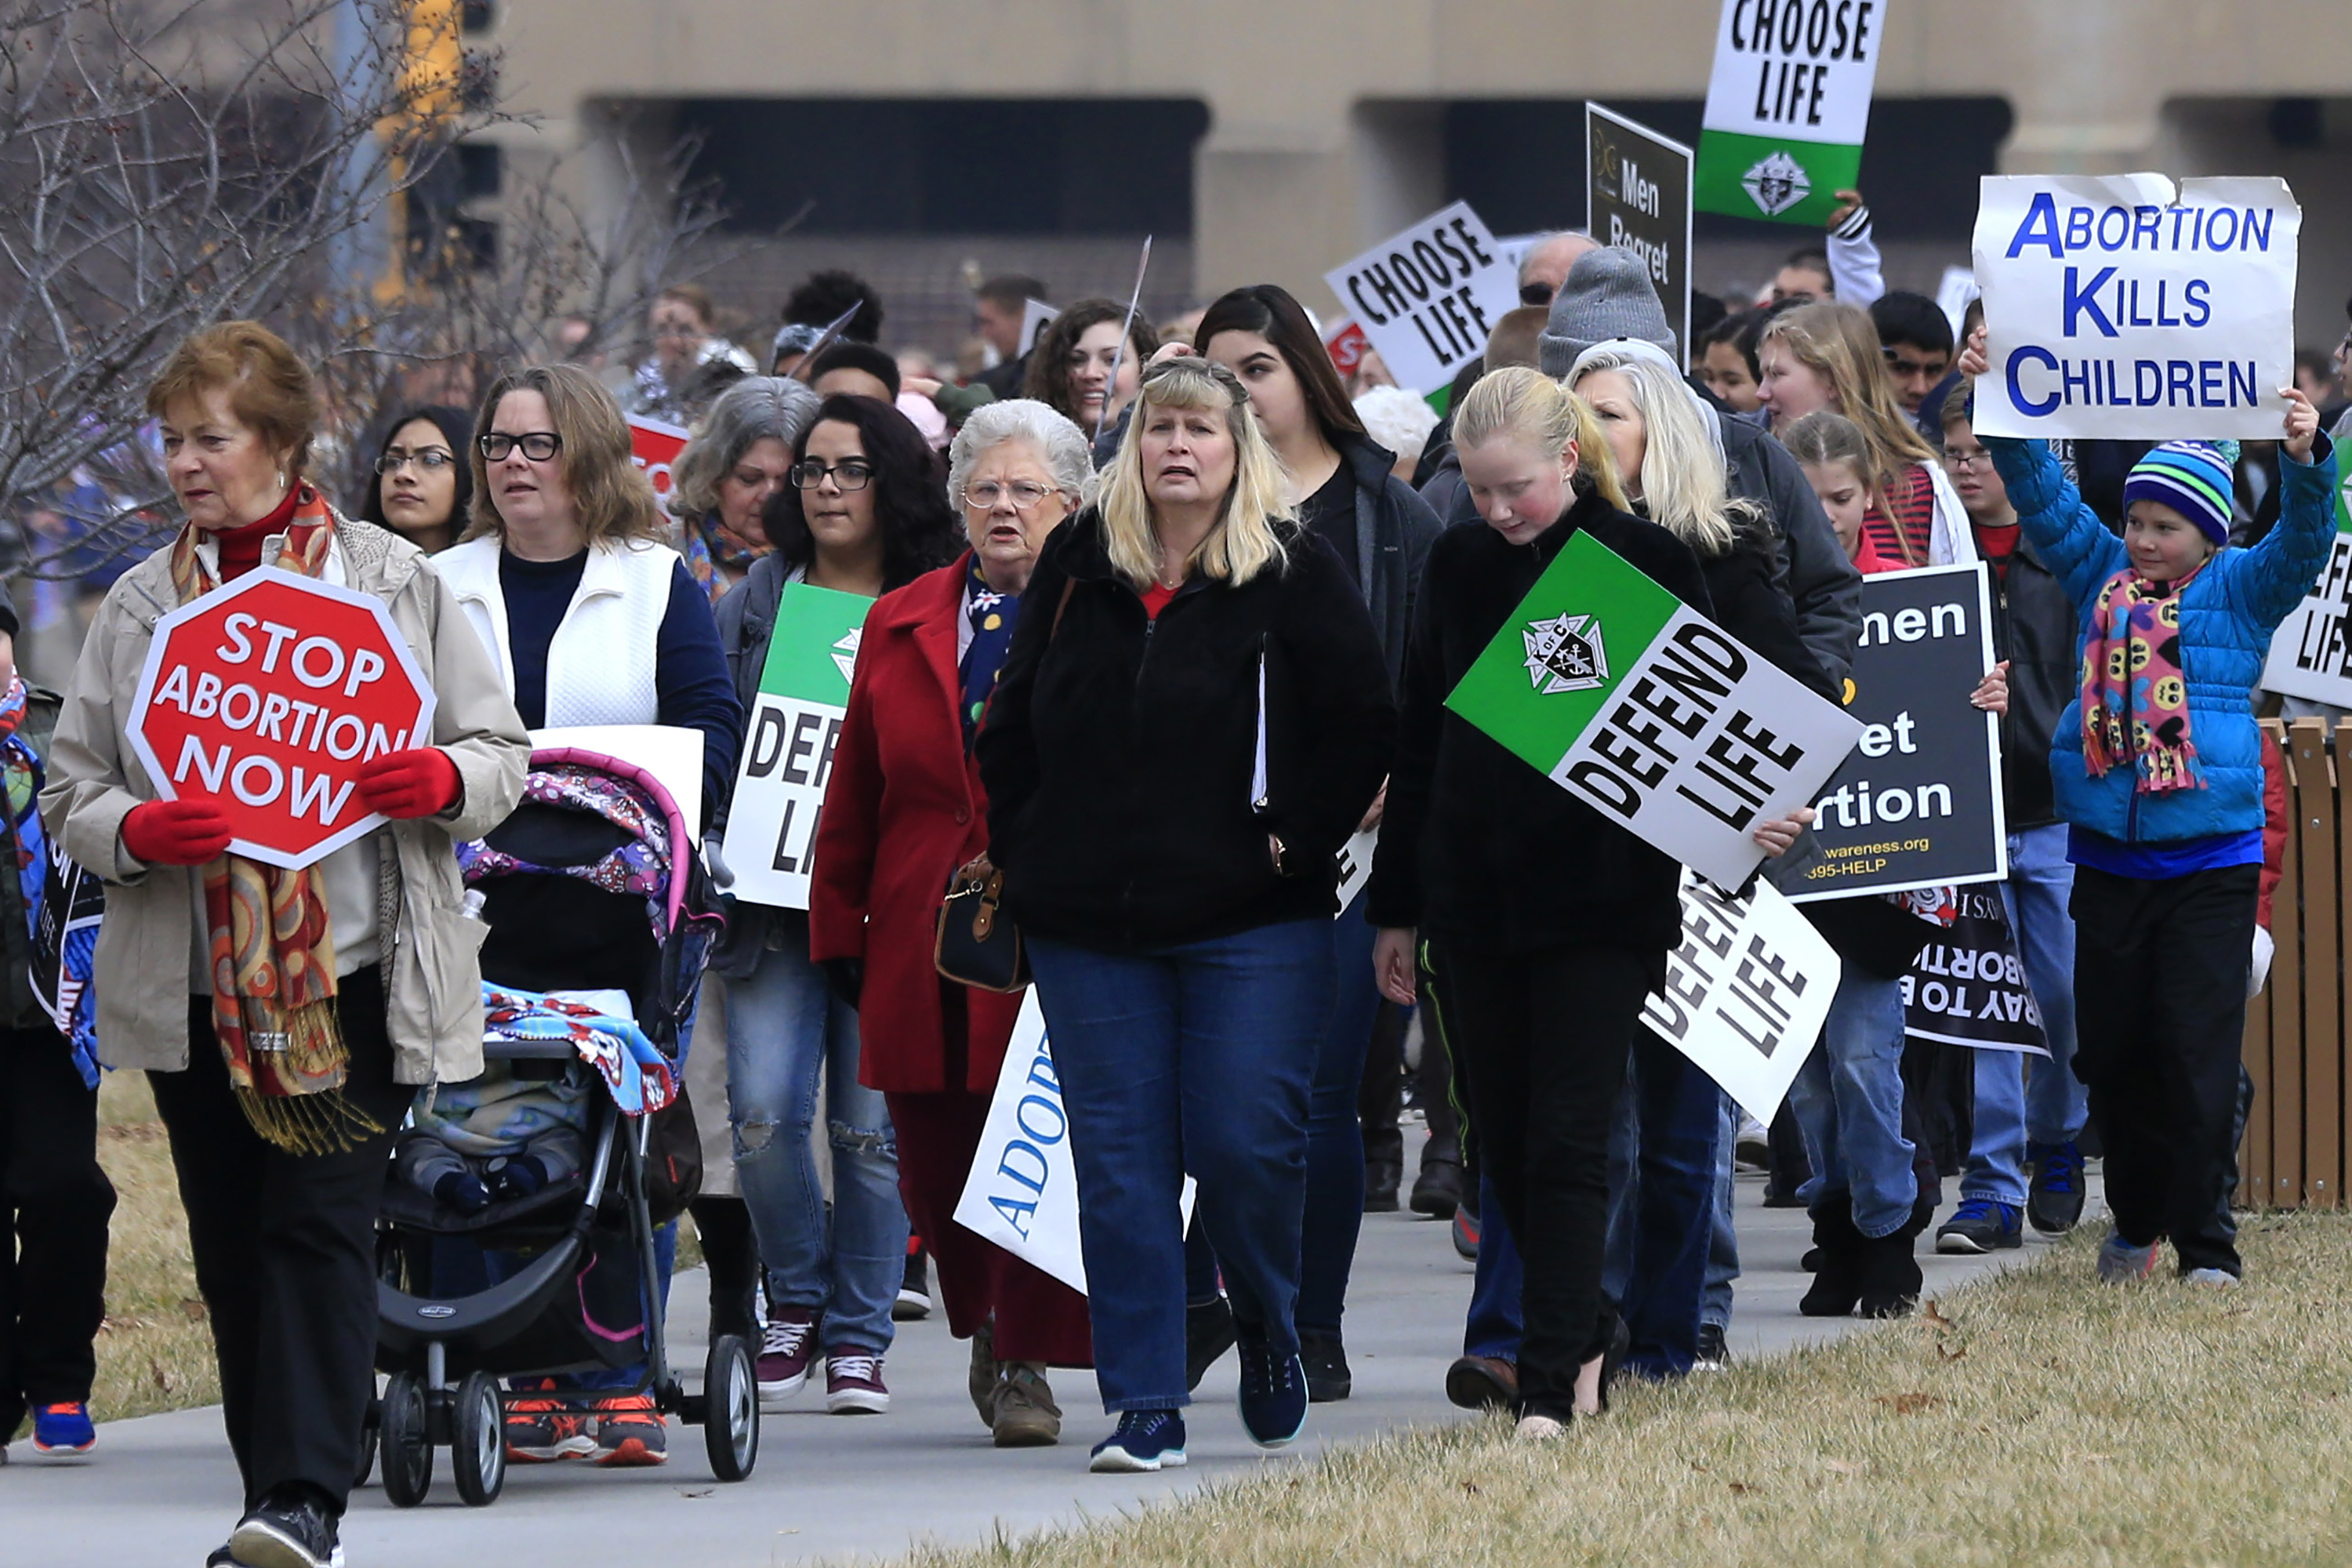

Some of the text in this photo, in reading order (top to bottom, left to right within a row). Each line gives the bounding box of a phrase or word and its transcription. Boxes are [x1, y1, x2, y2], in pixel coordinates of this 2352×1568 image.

[1732, 0, 1872, 62] CHOOSE
[1755, 60, 1828, 127] LIFE
[1621, 158, 1659, 218] Men
[2005, 192, 2274, 260] ABORTION
[1347, 218, 1494, 326] CHOOSE
[2063, 267, 2211, 338] KILLS
[1413, 286, 1491, 366] LIFE
[2005, 345, 2259, 418] CHILDREN
[216, 612, 385, 698] STOP
[1534, 624, 1567, 662] K OF C
[1858, 602, 1966, 648] men
[154, 665, 408, 764] ABORTION
[746, 706, 842, 787] DEF
[1566, 623, 1748, 819] DEFEND
[174, 735, 357, 826] NOW
[1675, 710, 1805, 832] LIFE
[1813, 782, 1952, 831] rtion
[771, 799, 823, 875] LI
[1807, 858, 1886, 880] 395-HELP
[1825, 838, 1929, 859] wareness.org
[1645, 877, 1757, 1040] DEFEN
[1912, 943, 2027, 990] BORTI
[1715, 933, 1808, 1059] LIFE
[1922, 982, 1972, 1018] TO
[1977, 990, 2042, 1027] RAY
